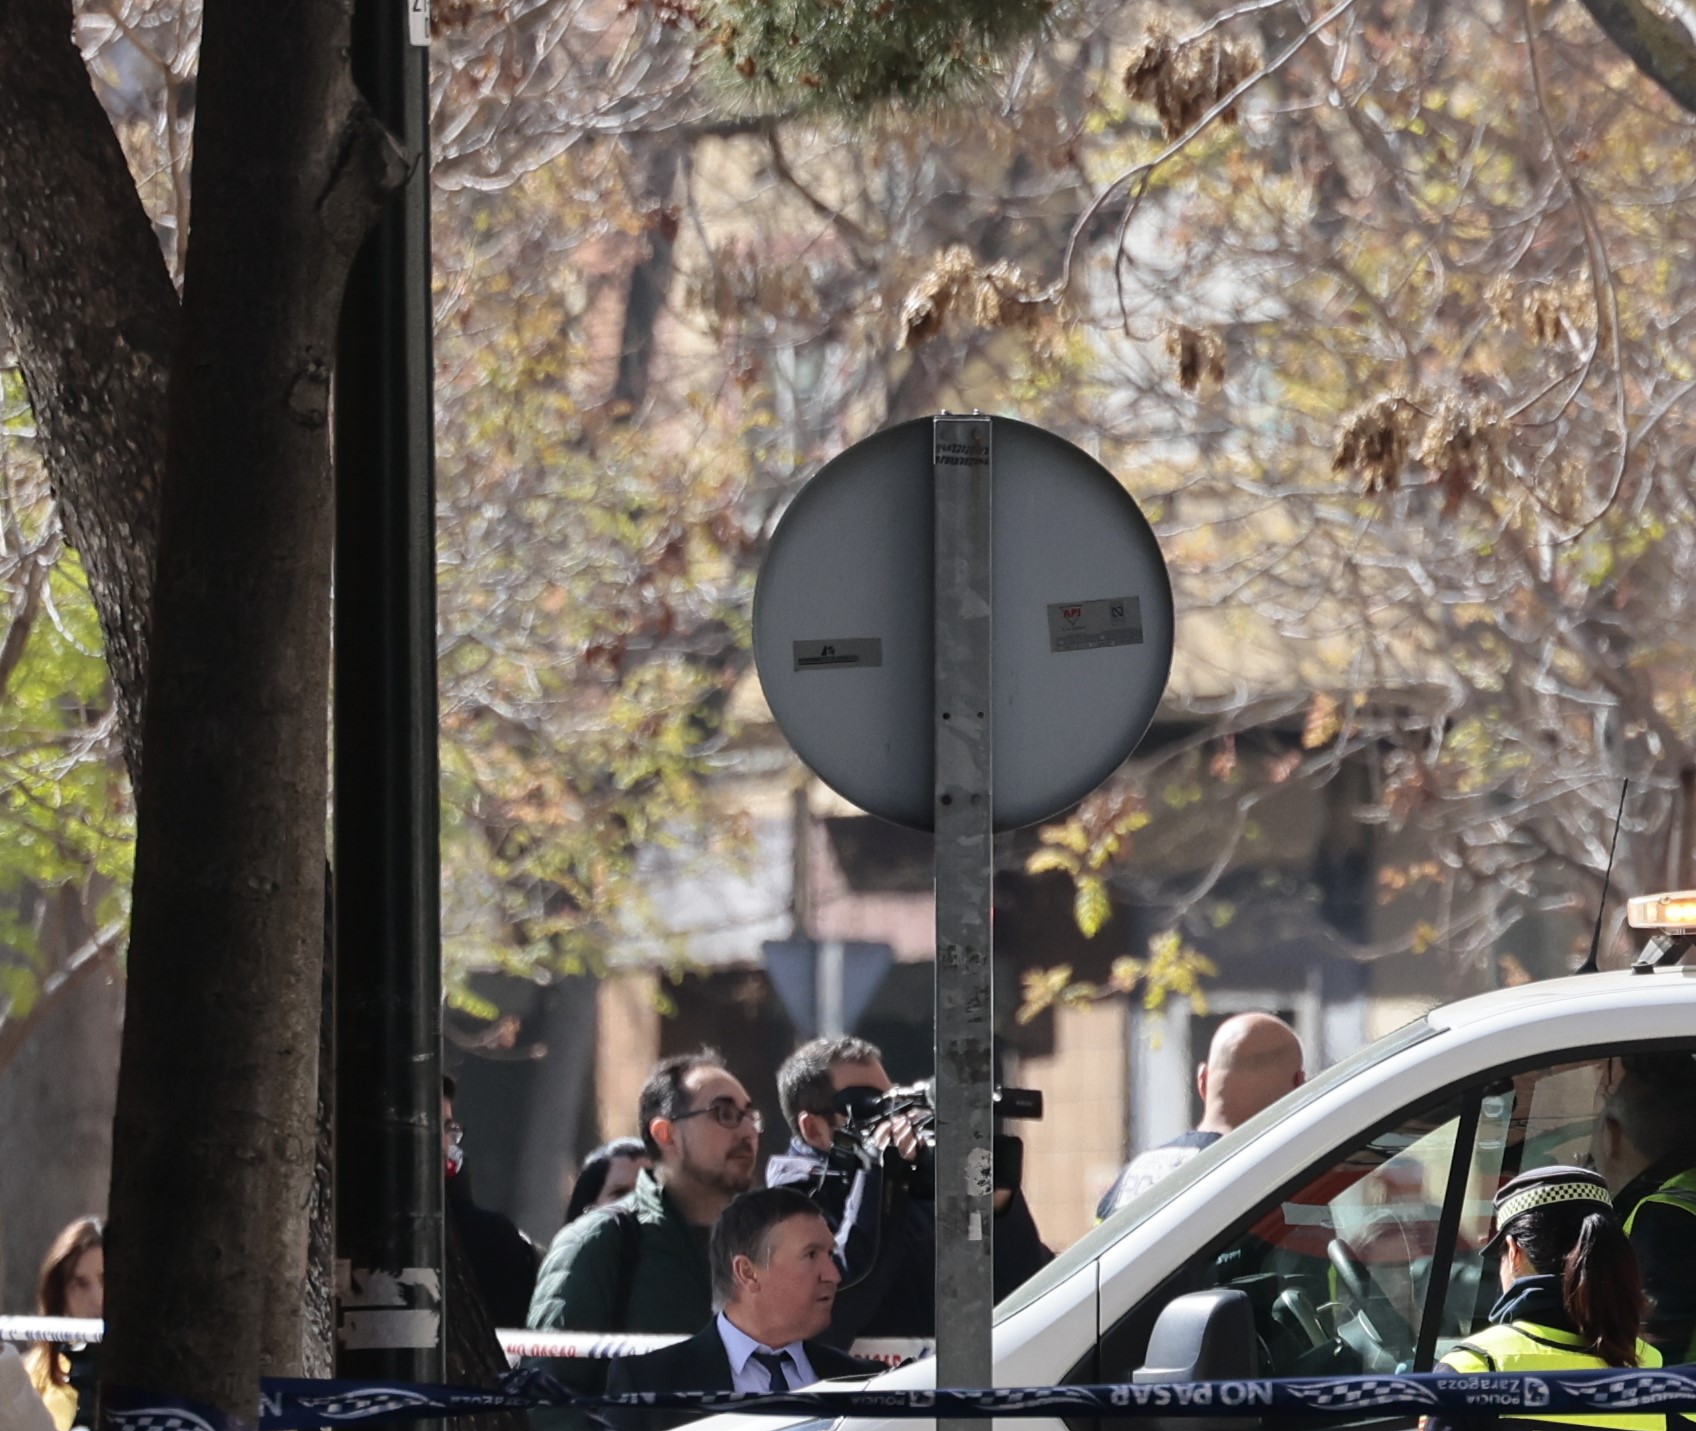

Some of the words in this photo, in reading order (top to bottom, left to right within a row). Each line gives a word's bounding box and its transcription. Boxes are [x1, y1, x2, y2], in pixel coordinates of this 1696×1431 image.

[1111, 1383, 1213, 1406] PASAR
[1219, 1382, 1273, 1405] NO
[1437, 1377, 1521, 1394] Zaragoza
[1466, 1393, 1521, 1405] POLICIA
